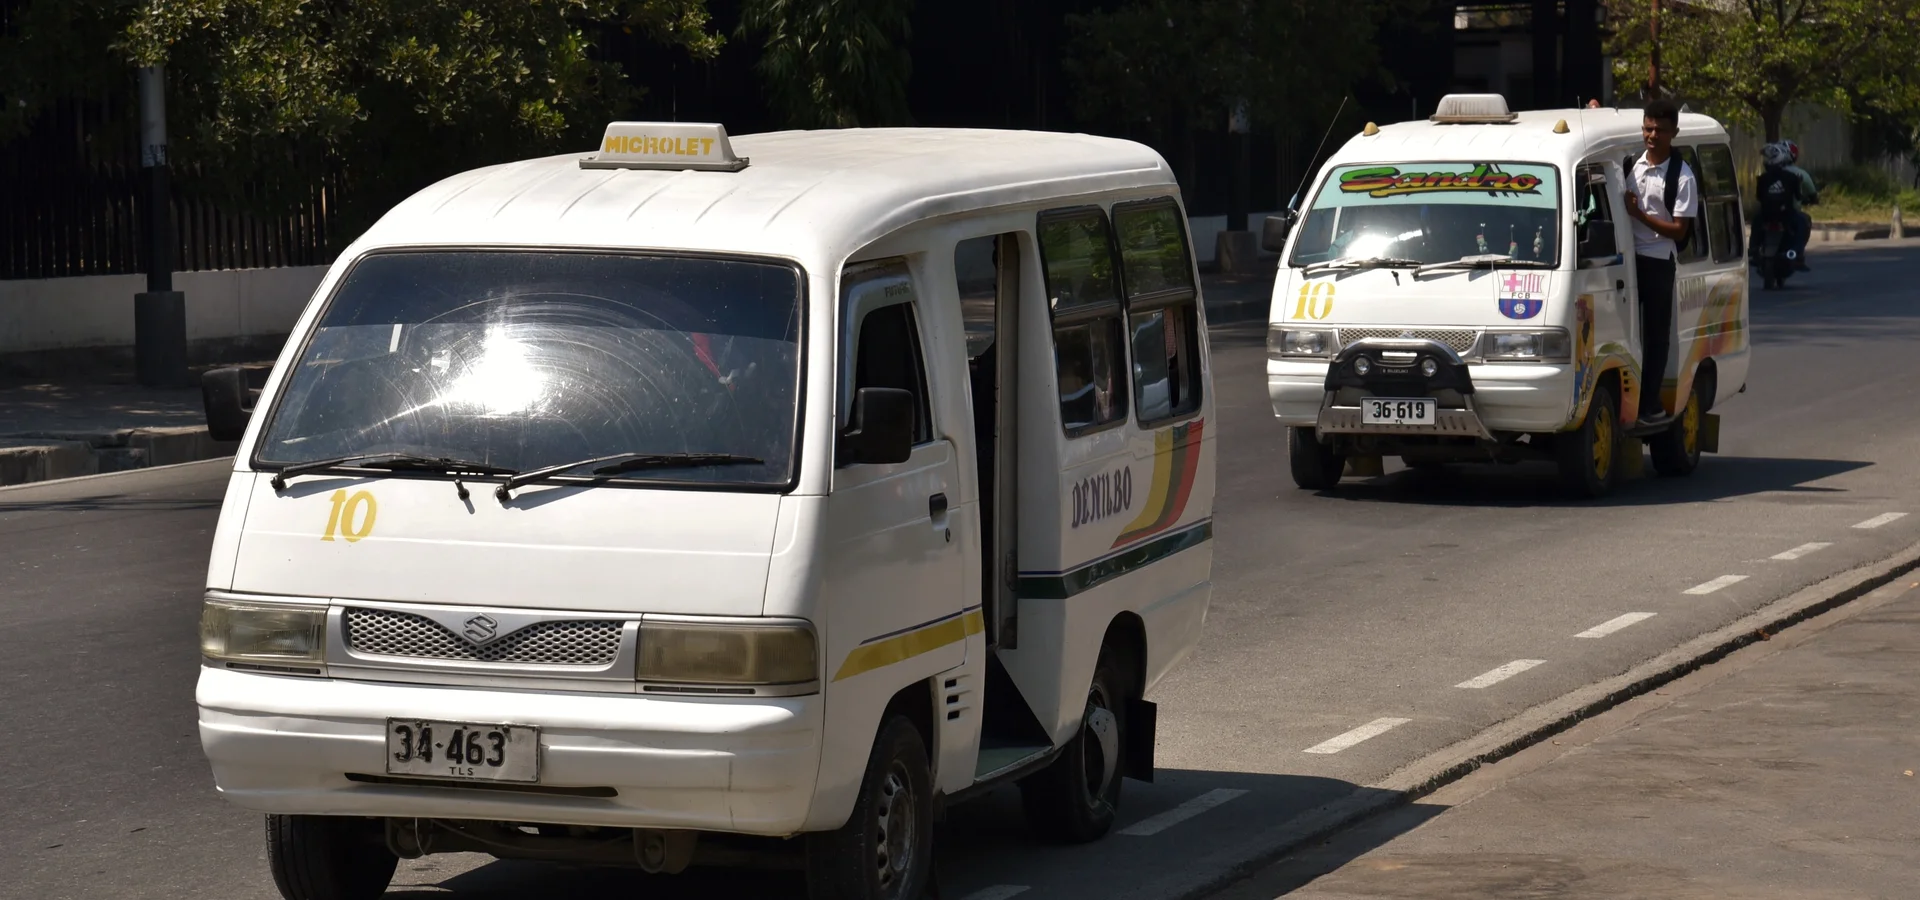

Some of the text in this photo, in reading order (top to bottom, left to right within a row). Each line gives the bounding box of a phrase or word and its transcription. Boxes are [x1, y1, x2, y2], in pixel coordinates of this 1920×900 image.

[605, 135, 714, 156] MICROLET
[1339, 163, 1543, 197] Sandro
[1291, 281, 1336, 320] 10
[1071, 464, 1132, 529] DENILBO
[320, 489, 377, 543] 10
[449, 766, 474, 776] TLS
